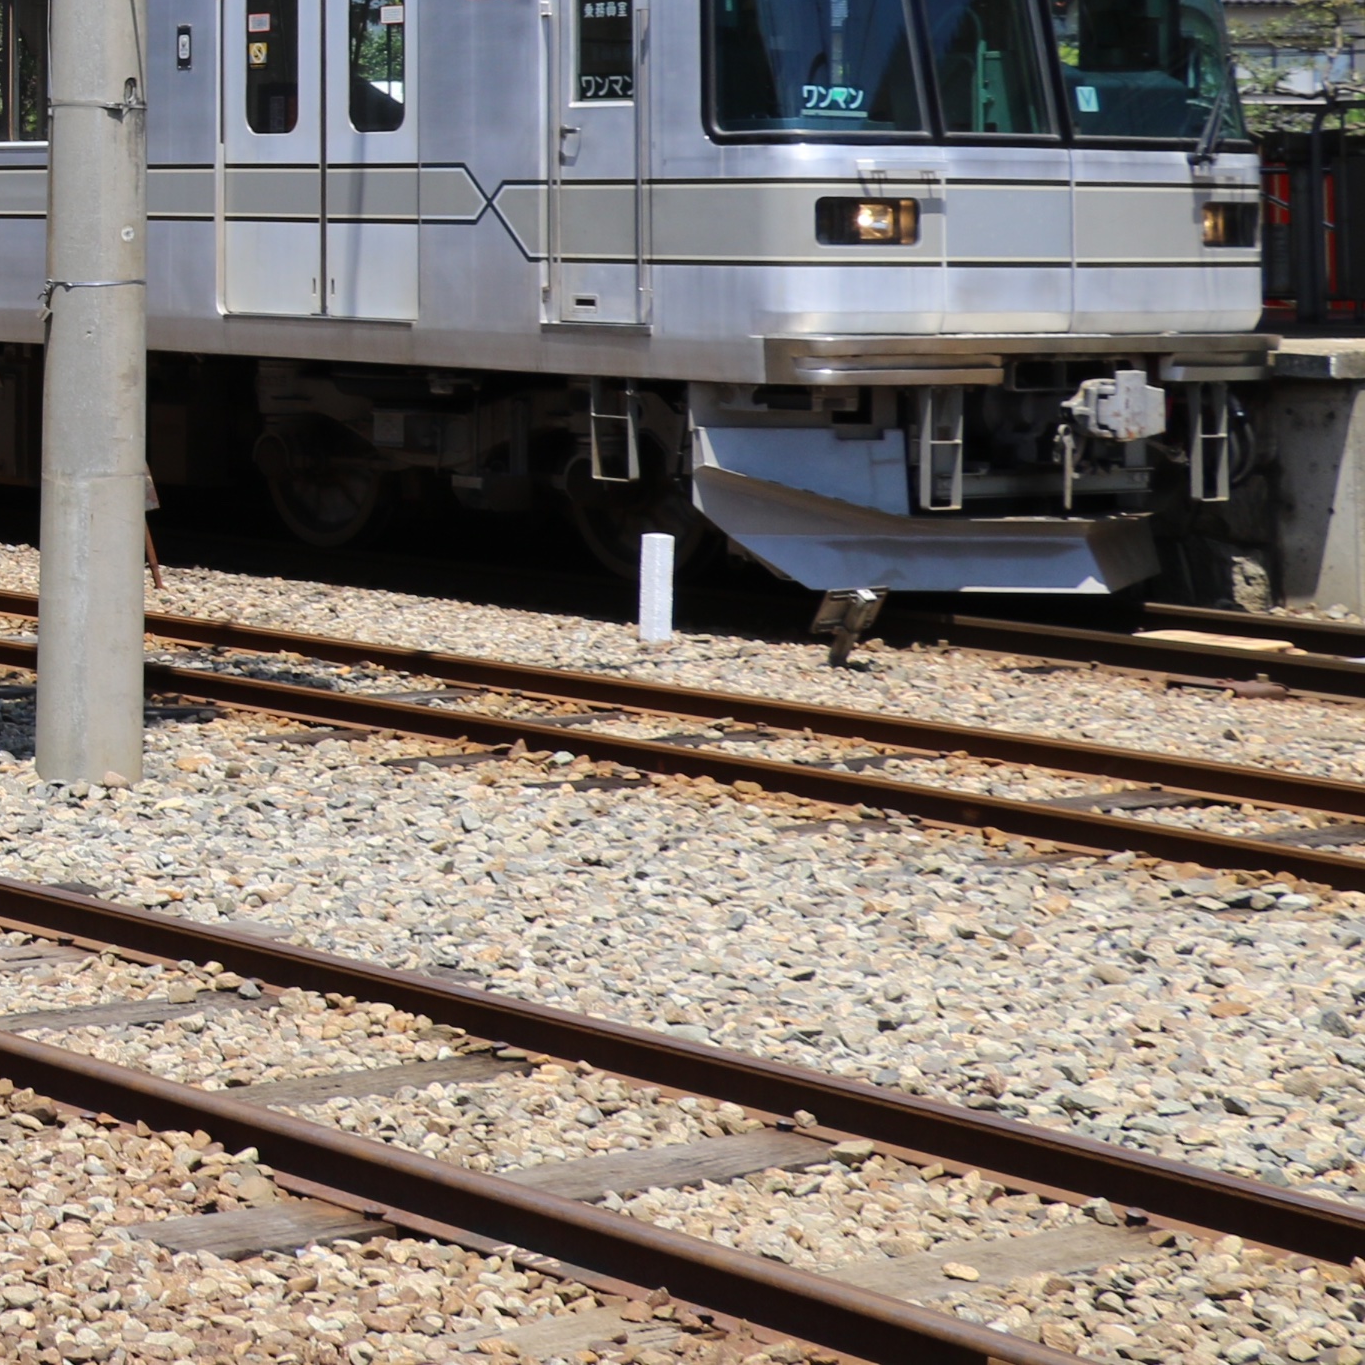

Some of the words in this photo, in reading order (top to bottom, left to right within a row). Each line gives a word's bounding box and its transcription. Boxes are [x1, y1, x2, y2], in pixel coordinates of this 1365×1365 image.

[584, 1, 628, 18] 乗務員室
[581, 75, 634, 97] ワンマン
[802, 85, 864, 109] ワンマン
